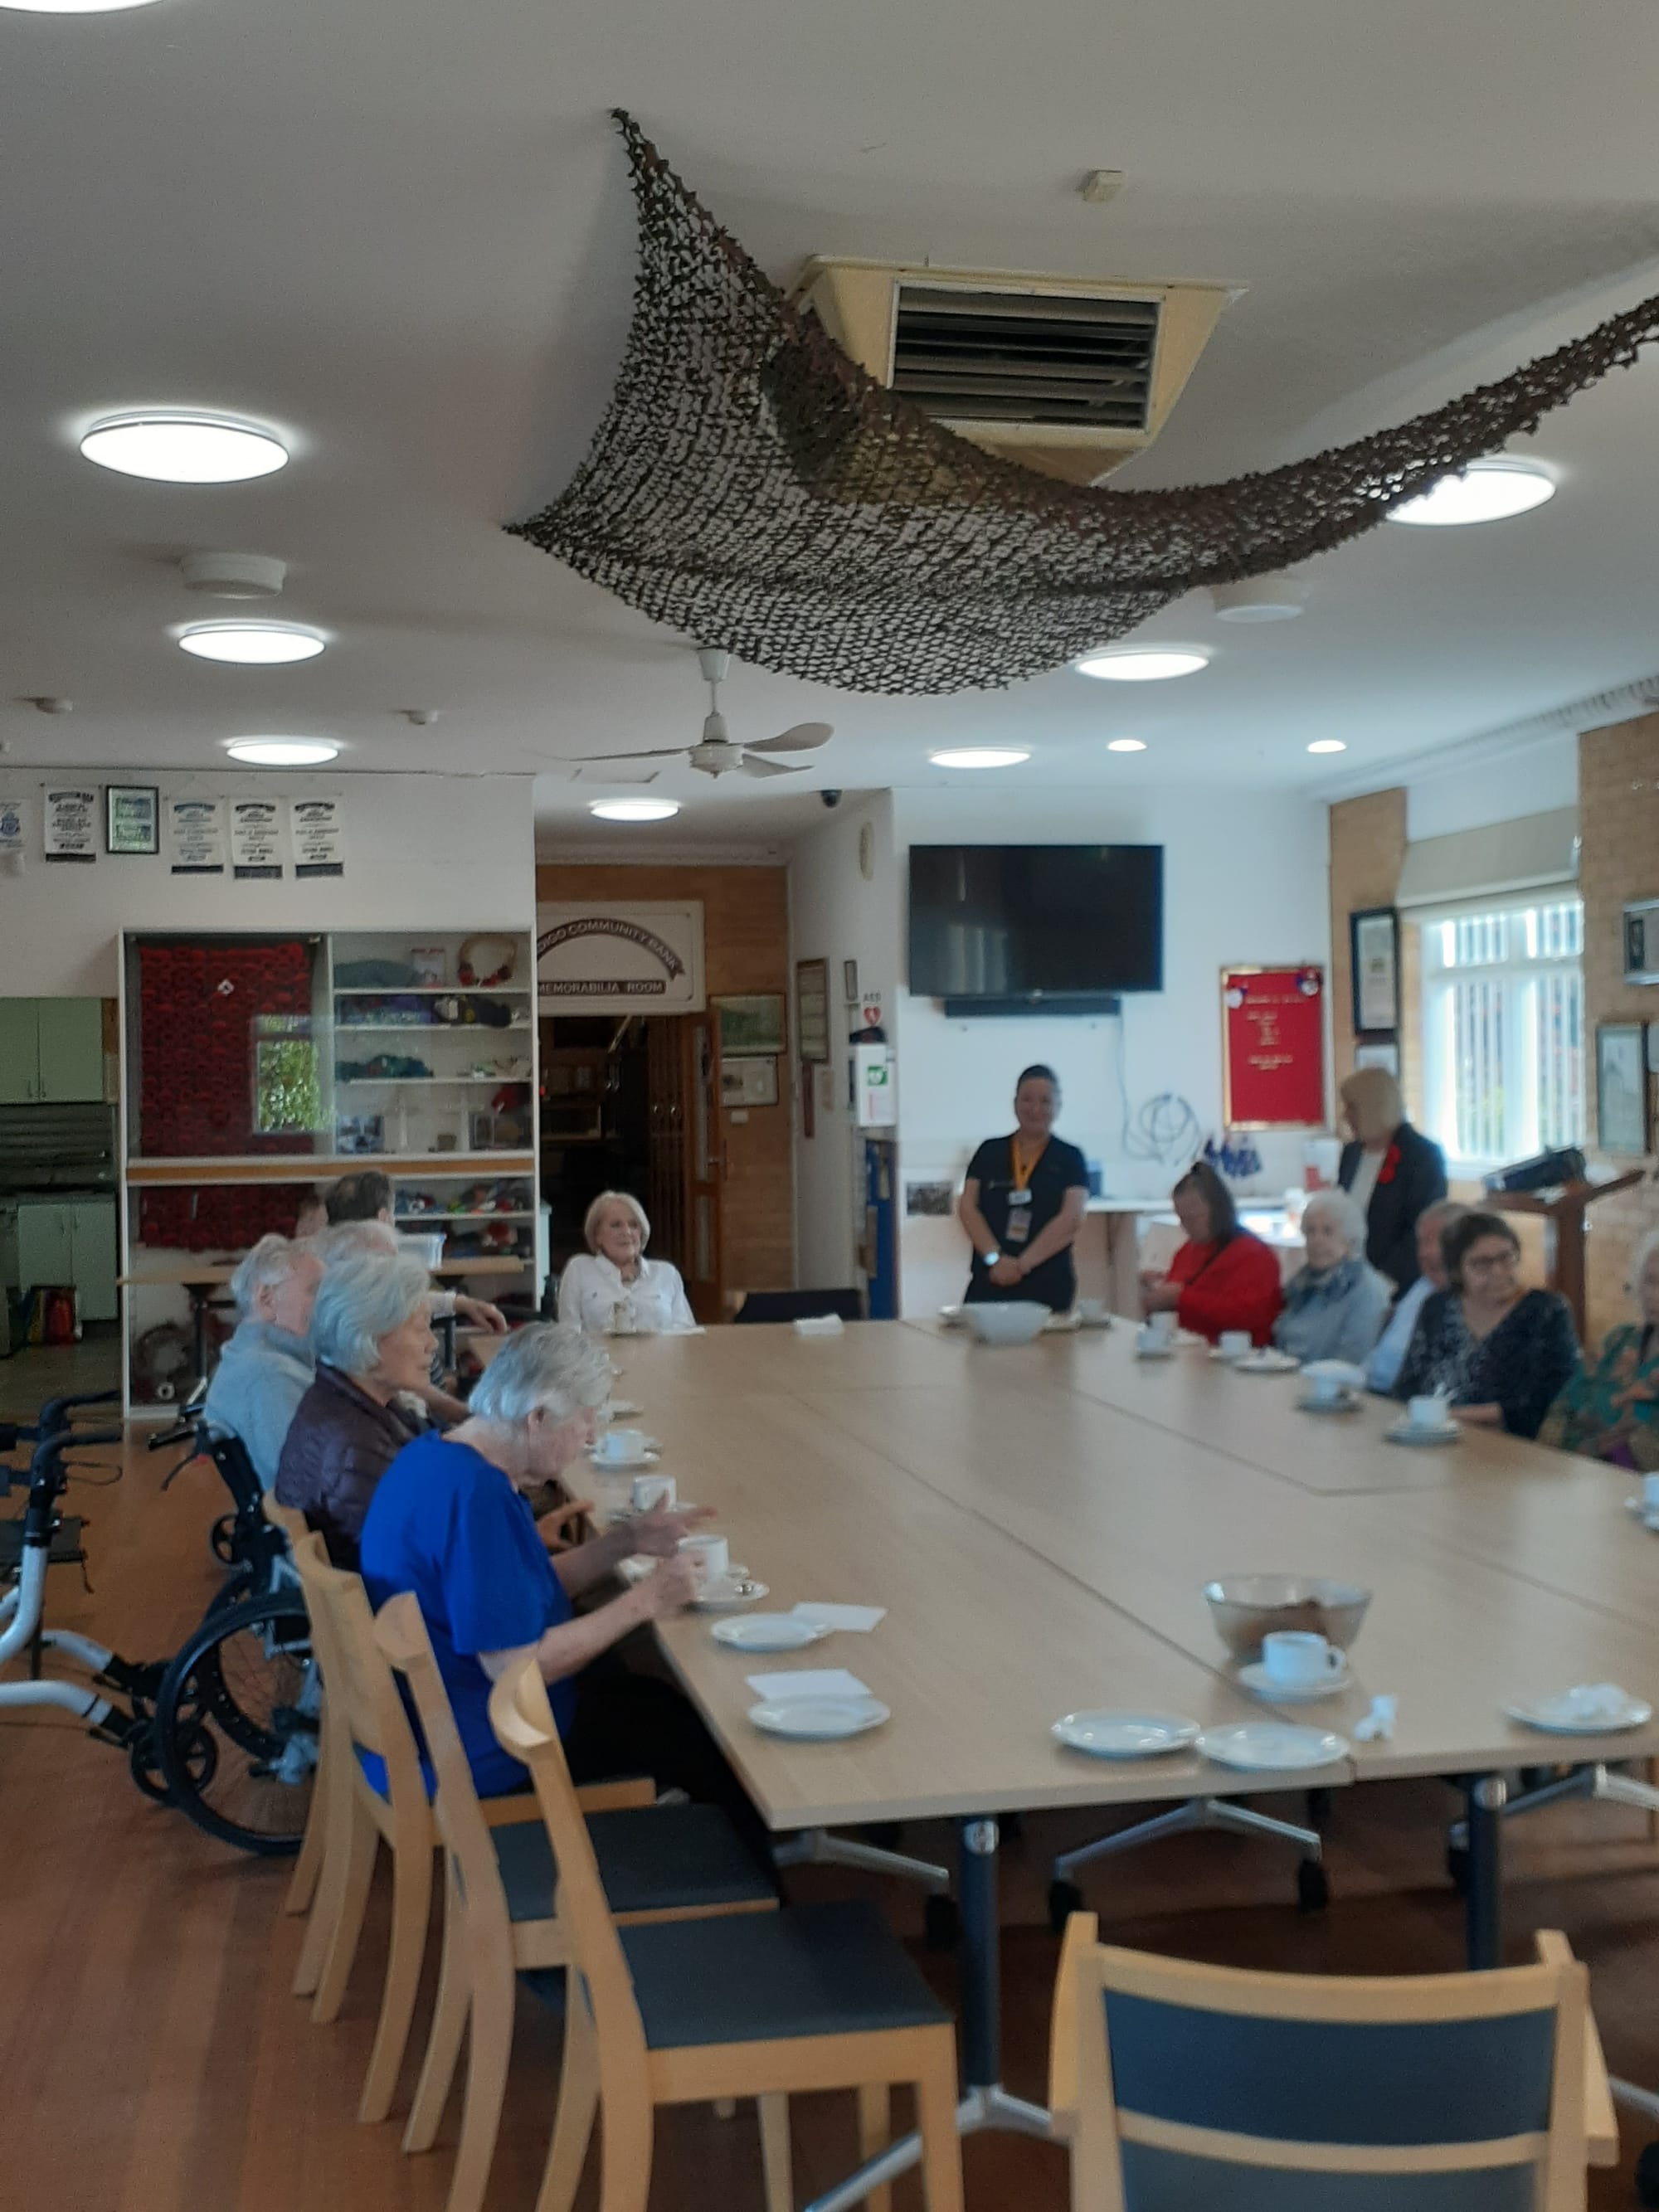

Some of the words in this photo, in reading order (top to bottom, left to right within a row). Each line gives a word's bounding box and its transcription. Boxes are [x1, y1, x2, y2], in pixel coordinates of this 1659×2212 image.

[568, 920, 648, 944] COMMUNITY
[649, 939, 678, 970] BANK
[538, 982, 620, 994] MEMORABILIA
[626, 981, 663, 993] ROOM
